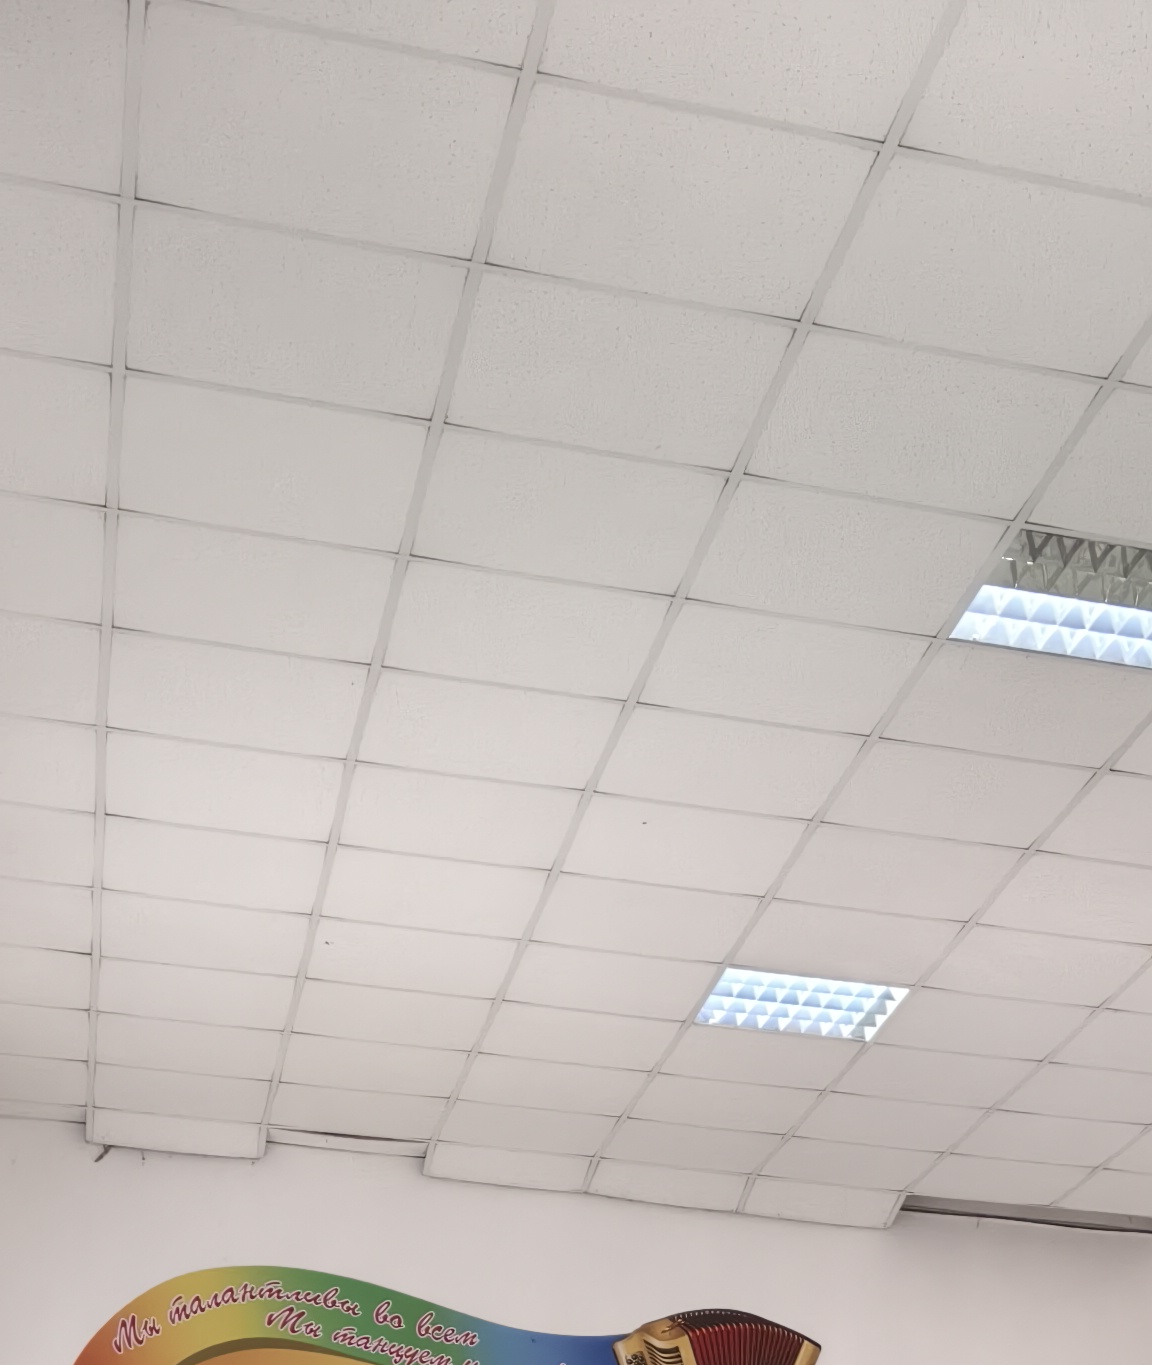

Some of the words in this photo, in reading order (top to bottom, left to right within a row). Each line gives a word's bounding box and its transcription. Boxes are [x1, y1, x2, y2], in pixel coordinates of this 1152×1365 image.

[112, 1313, 161, 1354] Мы
[168, 1281, 361, 1325] талантливы
[373, 1300, 404, 1329] во
[416, 1311, 480, 1347] всем
[265, 1306, 323, 1339] Мы
